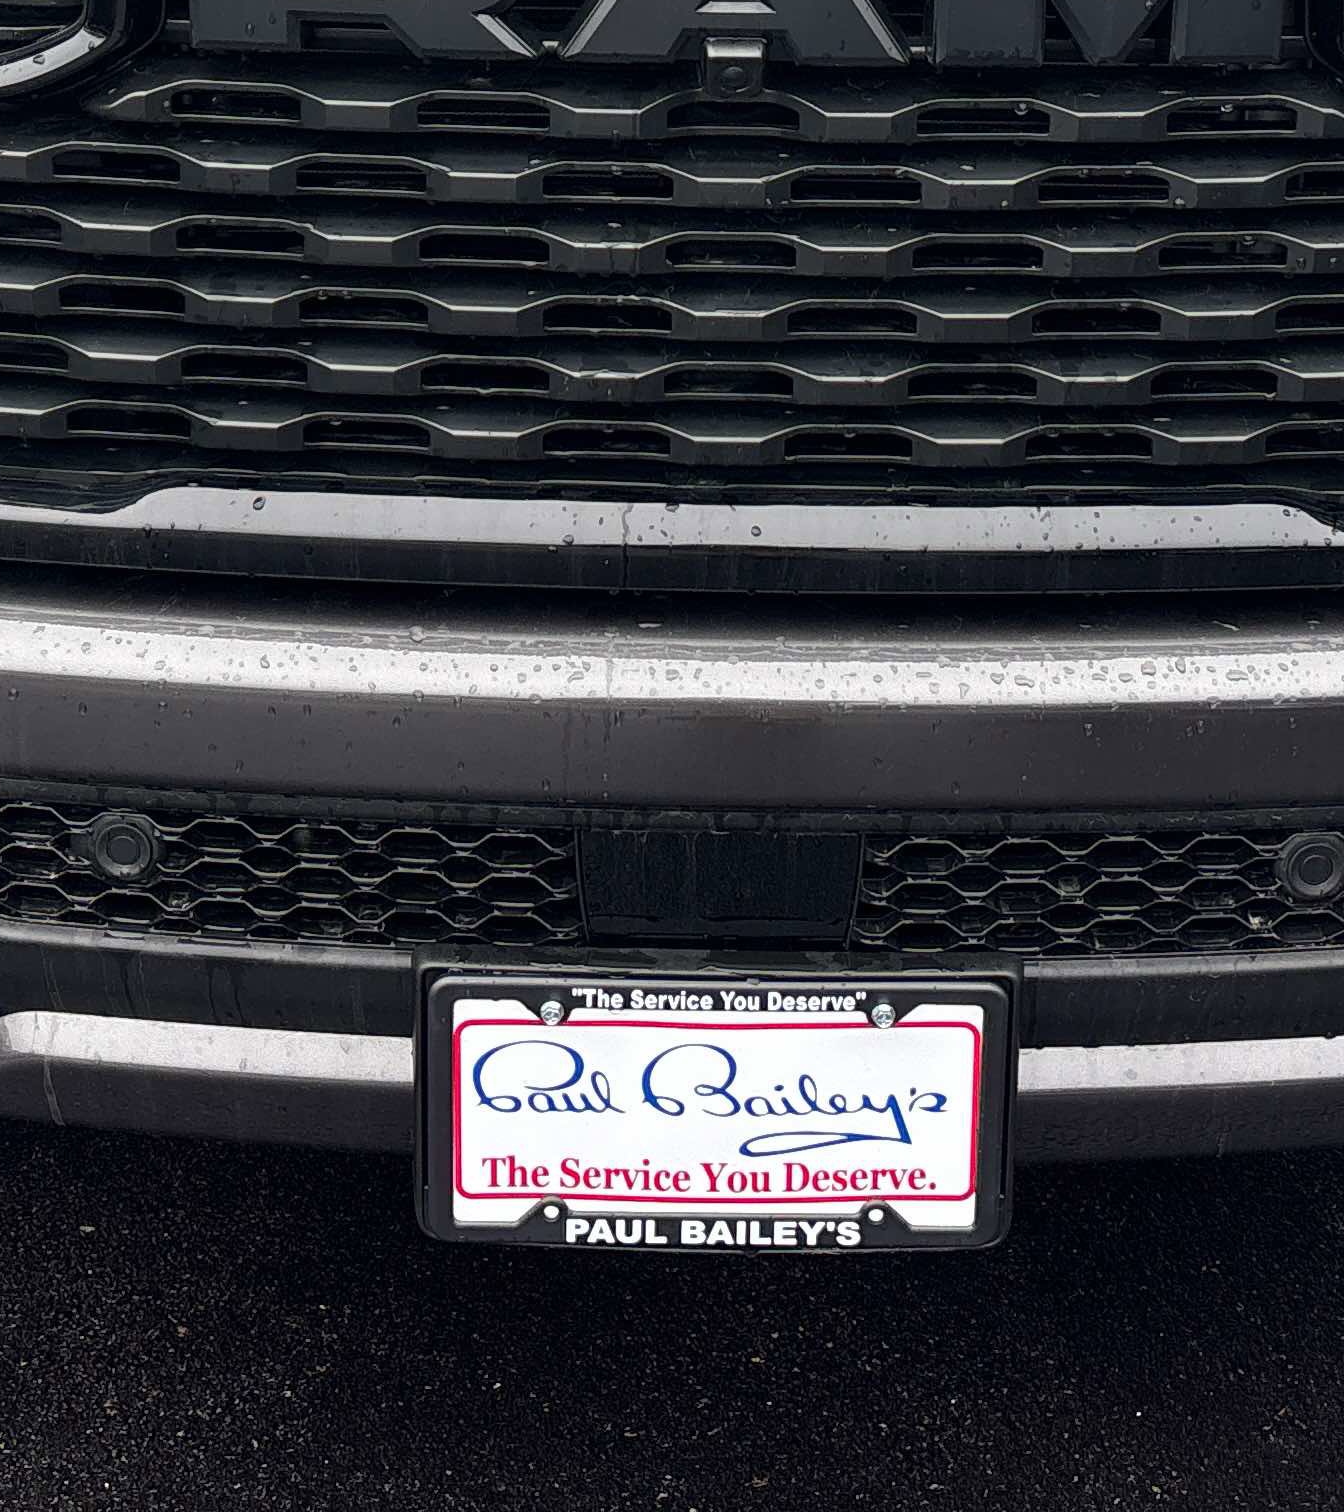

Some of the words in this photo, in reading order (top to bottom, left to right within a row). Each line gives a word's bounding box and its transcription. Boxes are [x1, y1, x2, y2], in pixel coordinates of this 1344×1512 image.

[630, 990, 714, 1011] Service
[720, 991, 760, 1011] You
[472, 1039, 626, 1114] Paul
[641, 1043, 949, 1157] Bailey's
[482, 1156, 550, 1189] The
[560, 1159, 691, 1193] Service
[700, 1161, 771, 1194] You
[783, 1162, 937, 1194] Deserve.
[565, 1218, 668, 1245] PAUL
[680, 1219, 862, 1247] BAILEY'S
